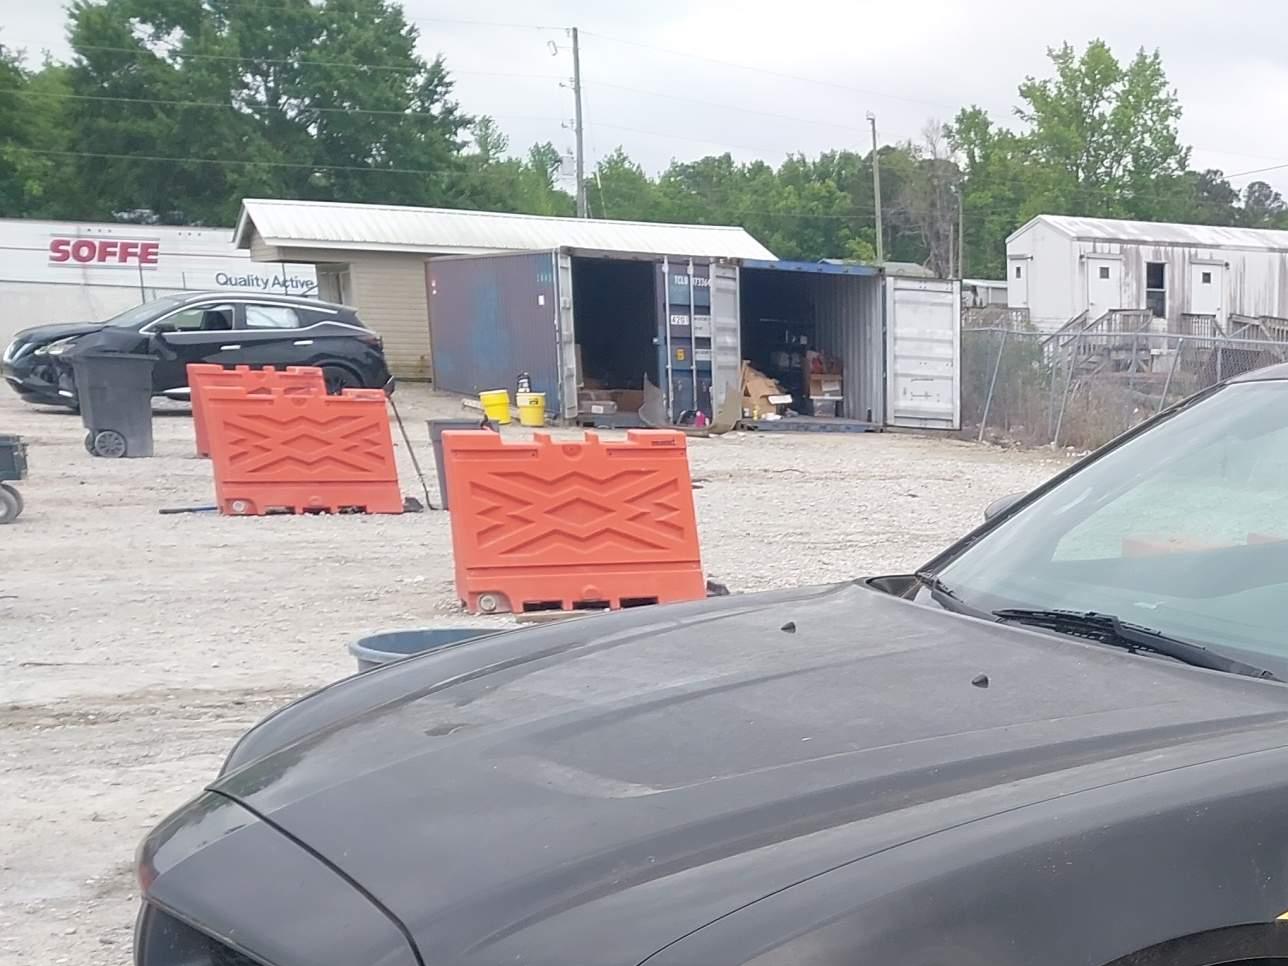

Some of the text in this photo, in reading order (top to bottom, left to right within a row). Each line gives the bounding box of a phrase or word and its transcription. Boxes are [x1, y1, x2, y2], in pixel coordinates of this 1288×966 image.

[49, 239, 160, 264] SOFFE
[215, 272, 315, 290] Quality Active
